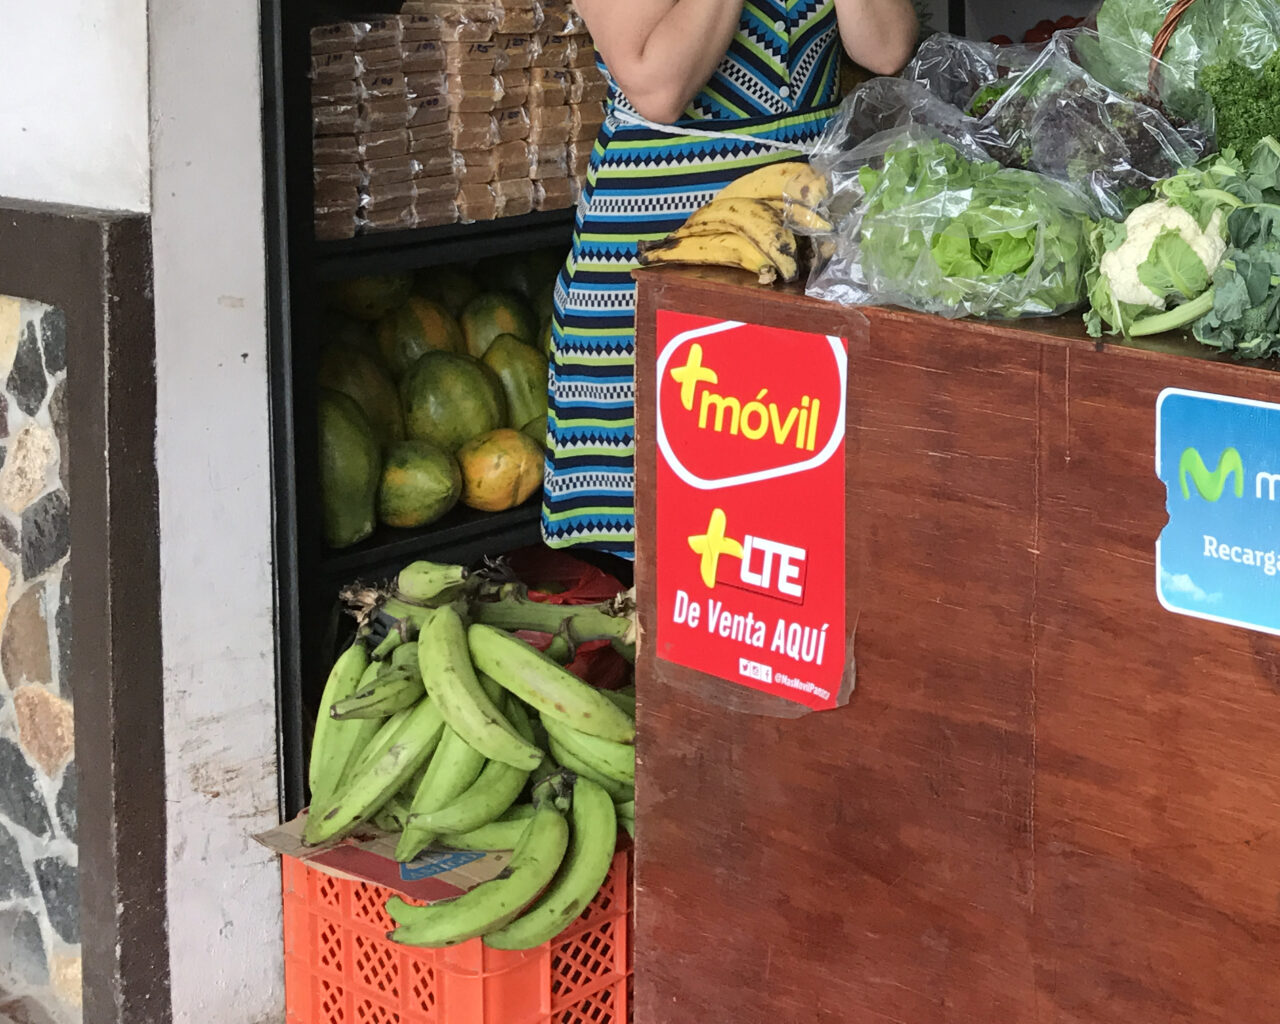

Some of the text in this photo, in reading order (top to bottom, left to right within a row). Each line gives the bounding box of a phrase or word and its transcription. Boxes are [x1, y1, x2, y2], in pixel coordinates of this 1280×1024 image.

[673, 590, 830, 665] De Venta AQUÍ
